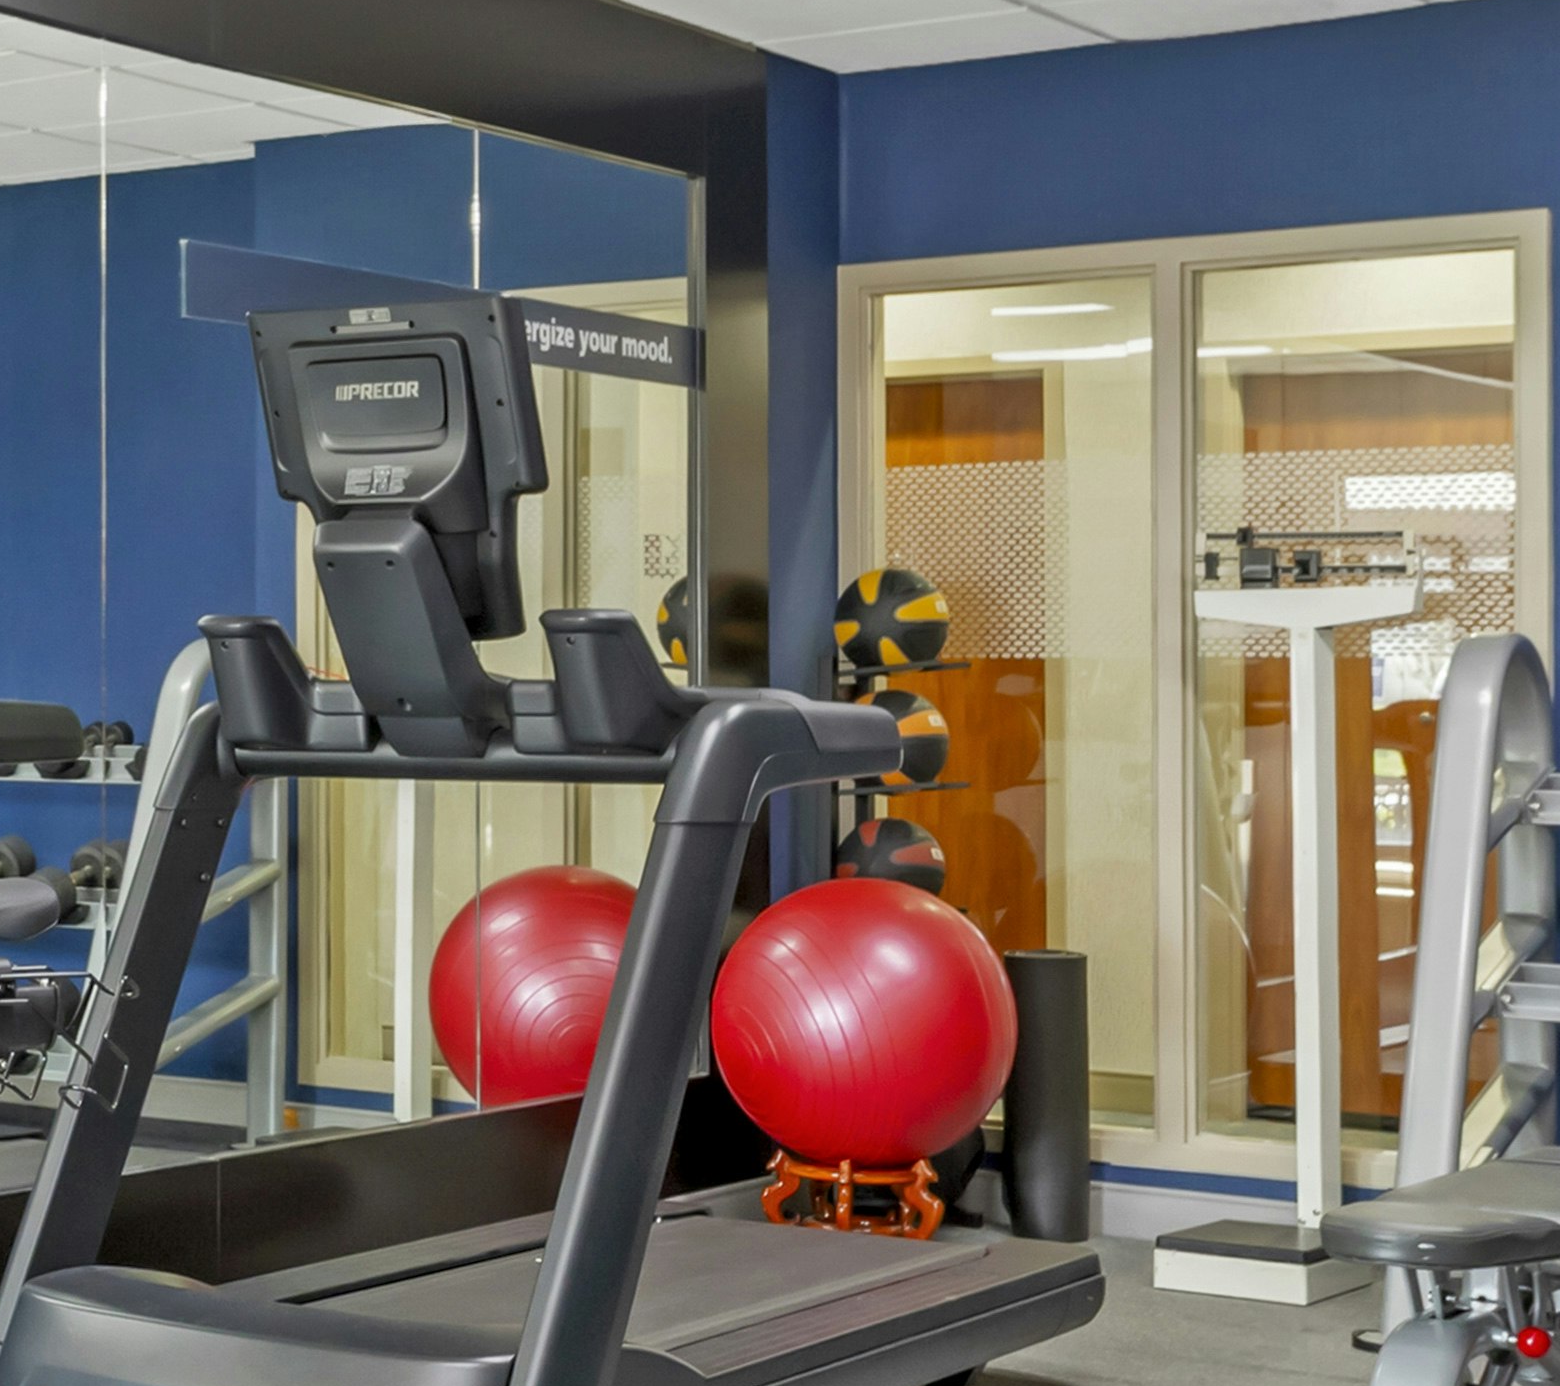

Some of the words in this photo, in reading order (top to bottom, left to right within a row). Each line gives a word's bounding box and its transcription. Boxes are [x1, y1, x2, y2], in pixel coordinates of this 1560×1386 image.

[524, 317, 575, 352] ergize
[578, 329, 618, 358] your
[622, 336, 673, 364] mood.
[344, 380, 420, 402] PRECOR
